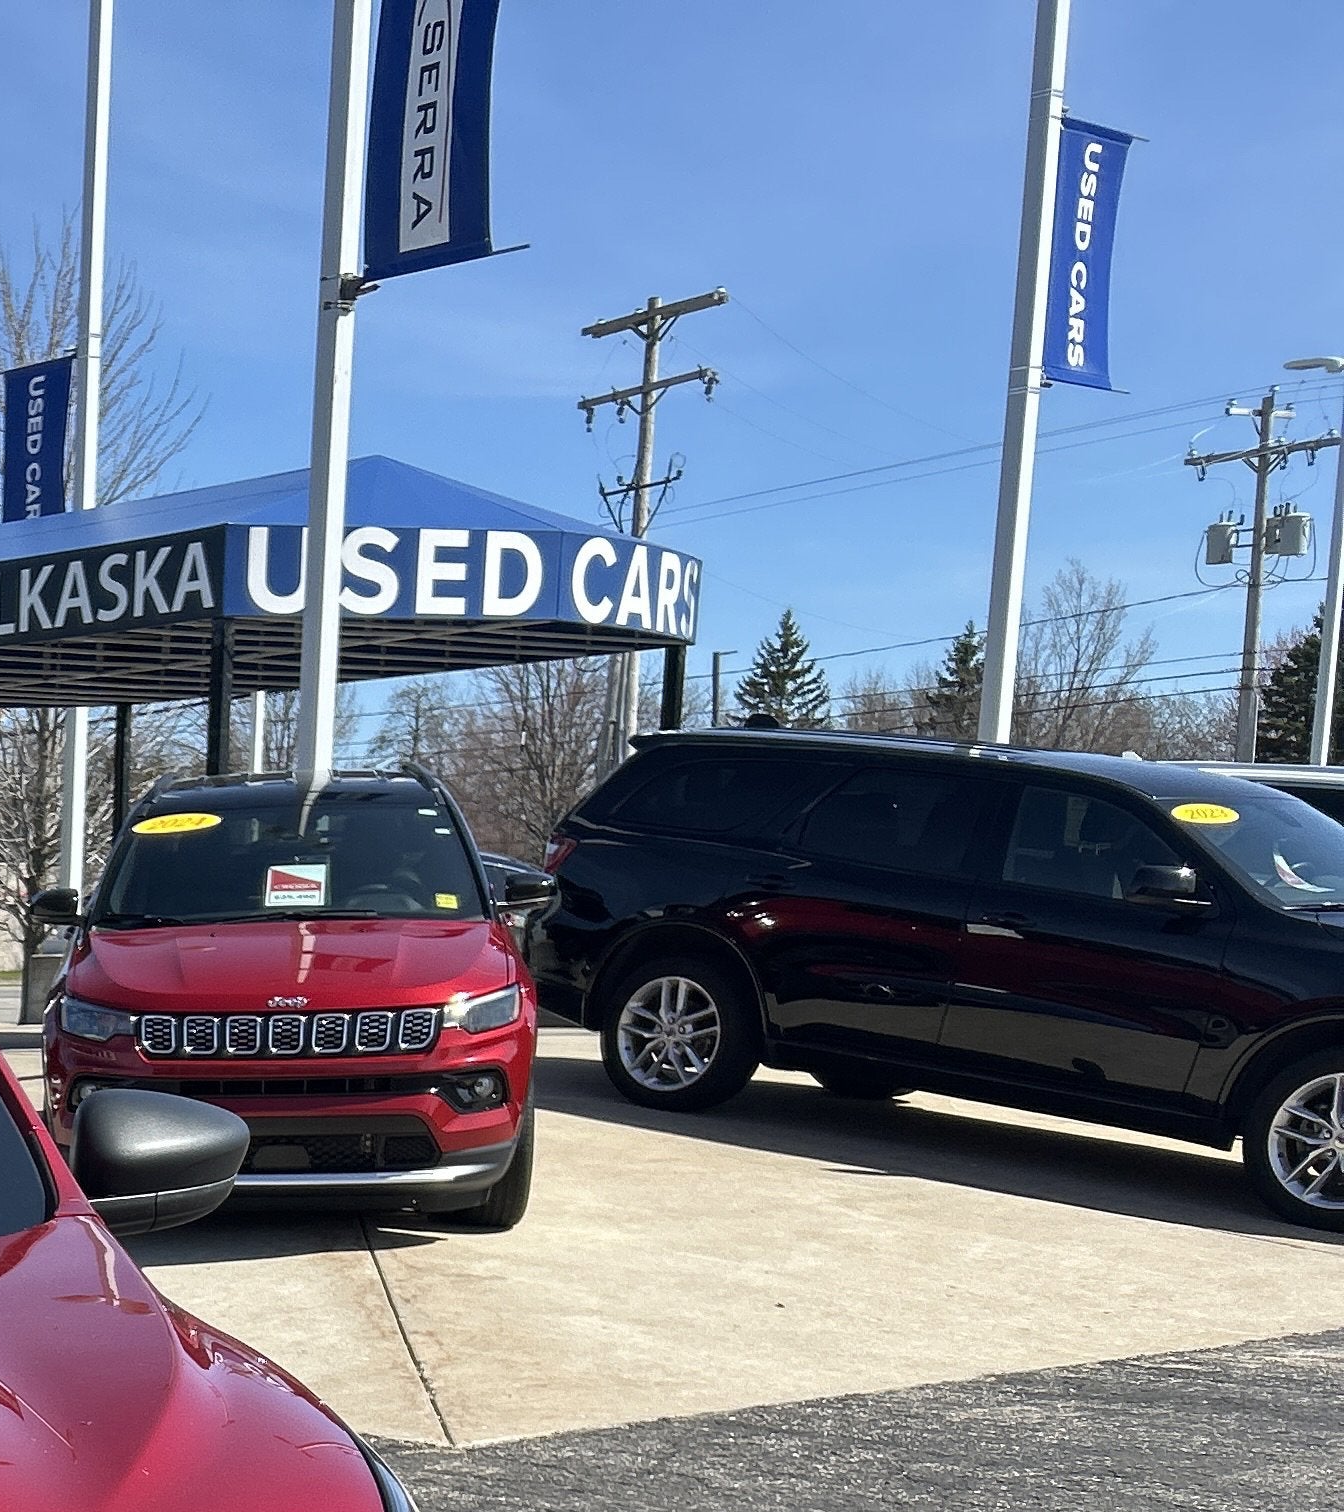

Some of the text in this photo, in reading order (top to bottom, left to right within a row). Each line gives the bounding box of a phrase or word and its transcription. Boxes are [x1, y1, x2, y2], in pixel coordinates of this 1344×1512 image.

[411, 20, 445, 231] SERRA
[1067, 142, 1103, 368] USED CARS
[24, 374, 47, 520] USED CAR
[246, 526, 699, 641] USED CARS
